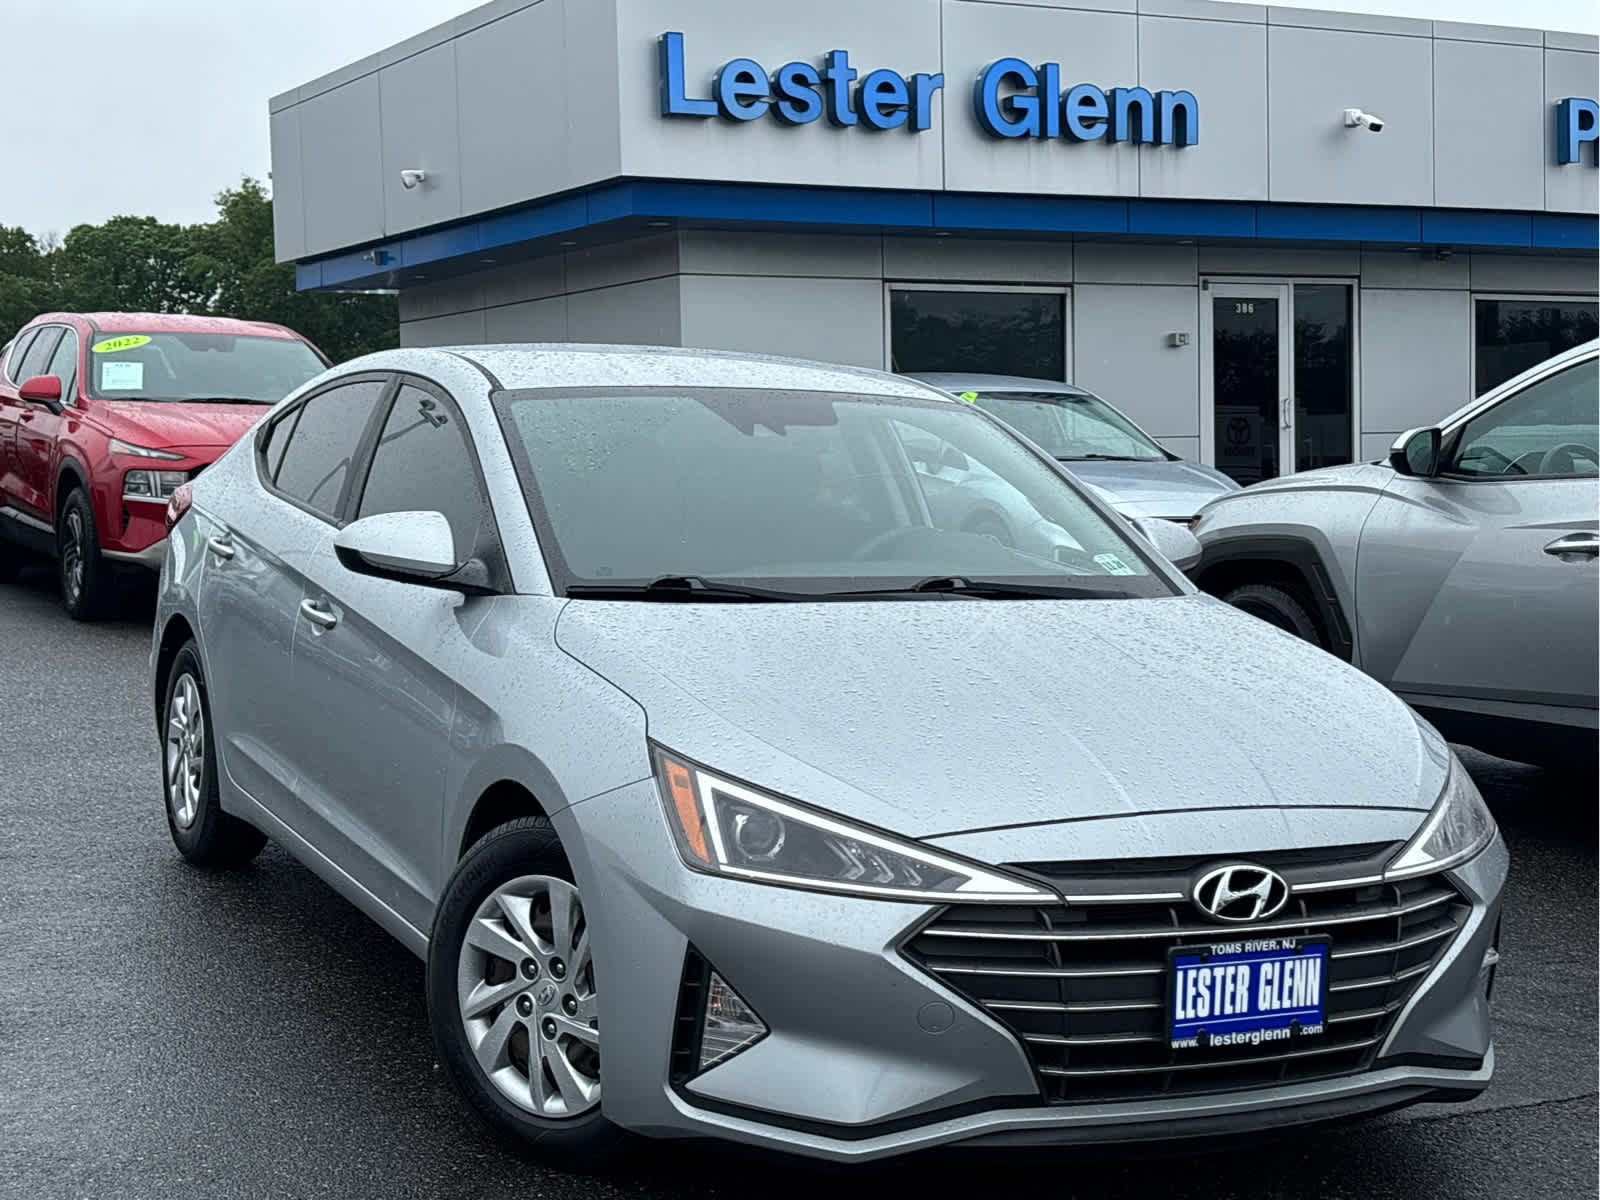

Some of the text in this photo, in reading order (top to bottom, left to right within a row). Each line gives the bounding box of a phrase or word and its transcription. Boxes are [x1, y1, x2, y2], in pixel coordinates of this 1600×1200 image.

[656, 31, 1199, 148] Lester Glenn
[104, 337, 140, 349] 2022
[1211, 943, 1242, 956] TOMS
[1282, 938, 1296, 949] NJ
[1175, 958, 1321, 1020] LESTER GLENN
[1210, 1028, 1291, 1047] lesterglenn
[1299, 1025, 1323, 1036] .com
